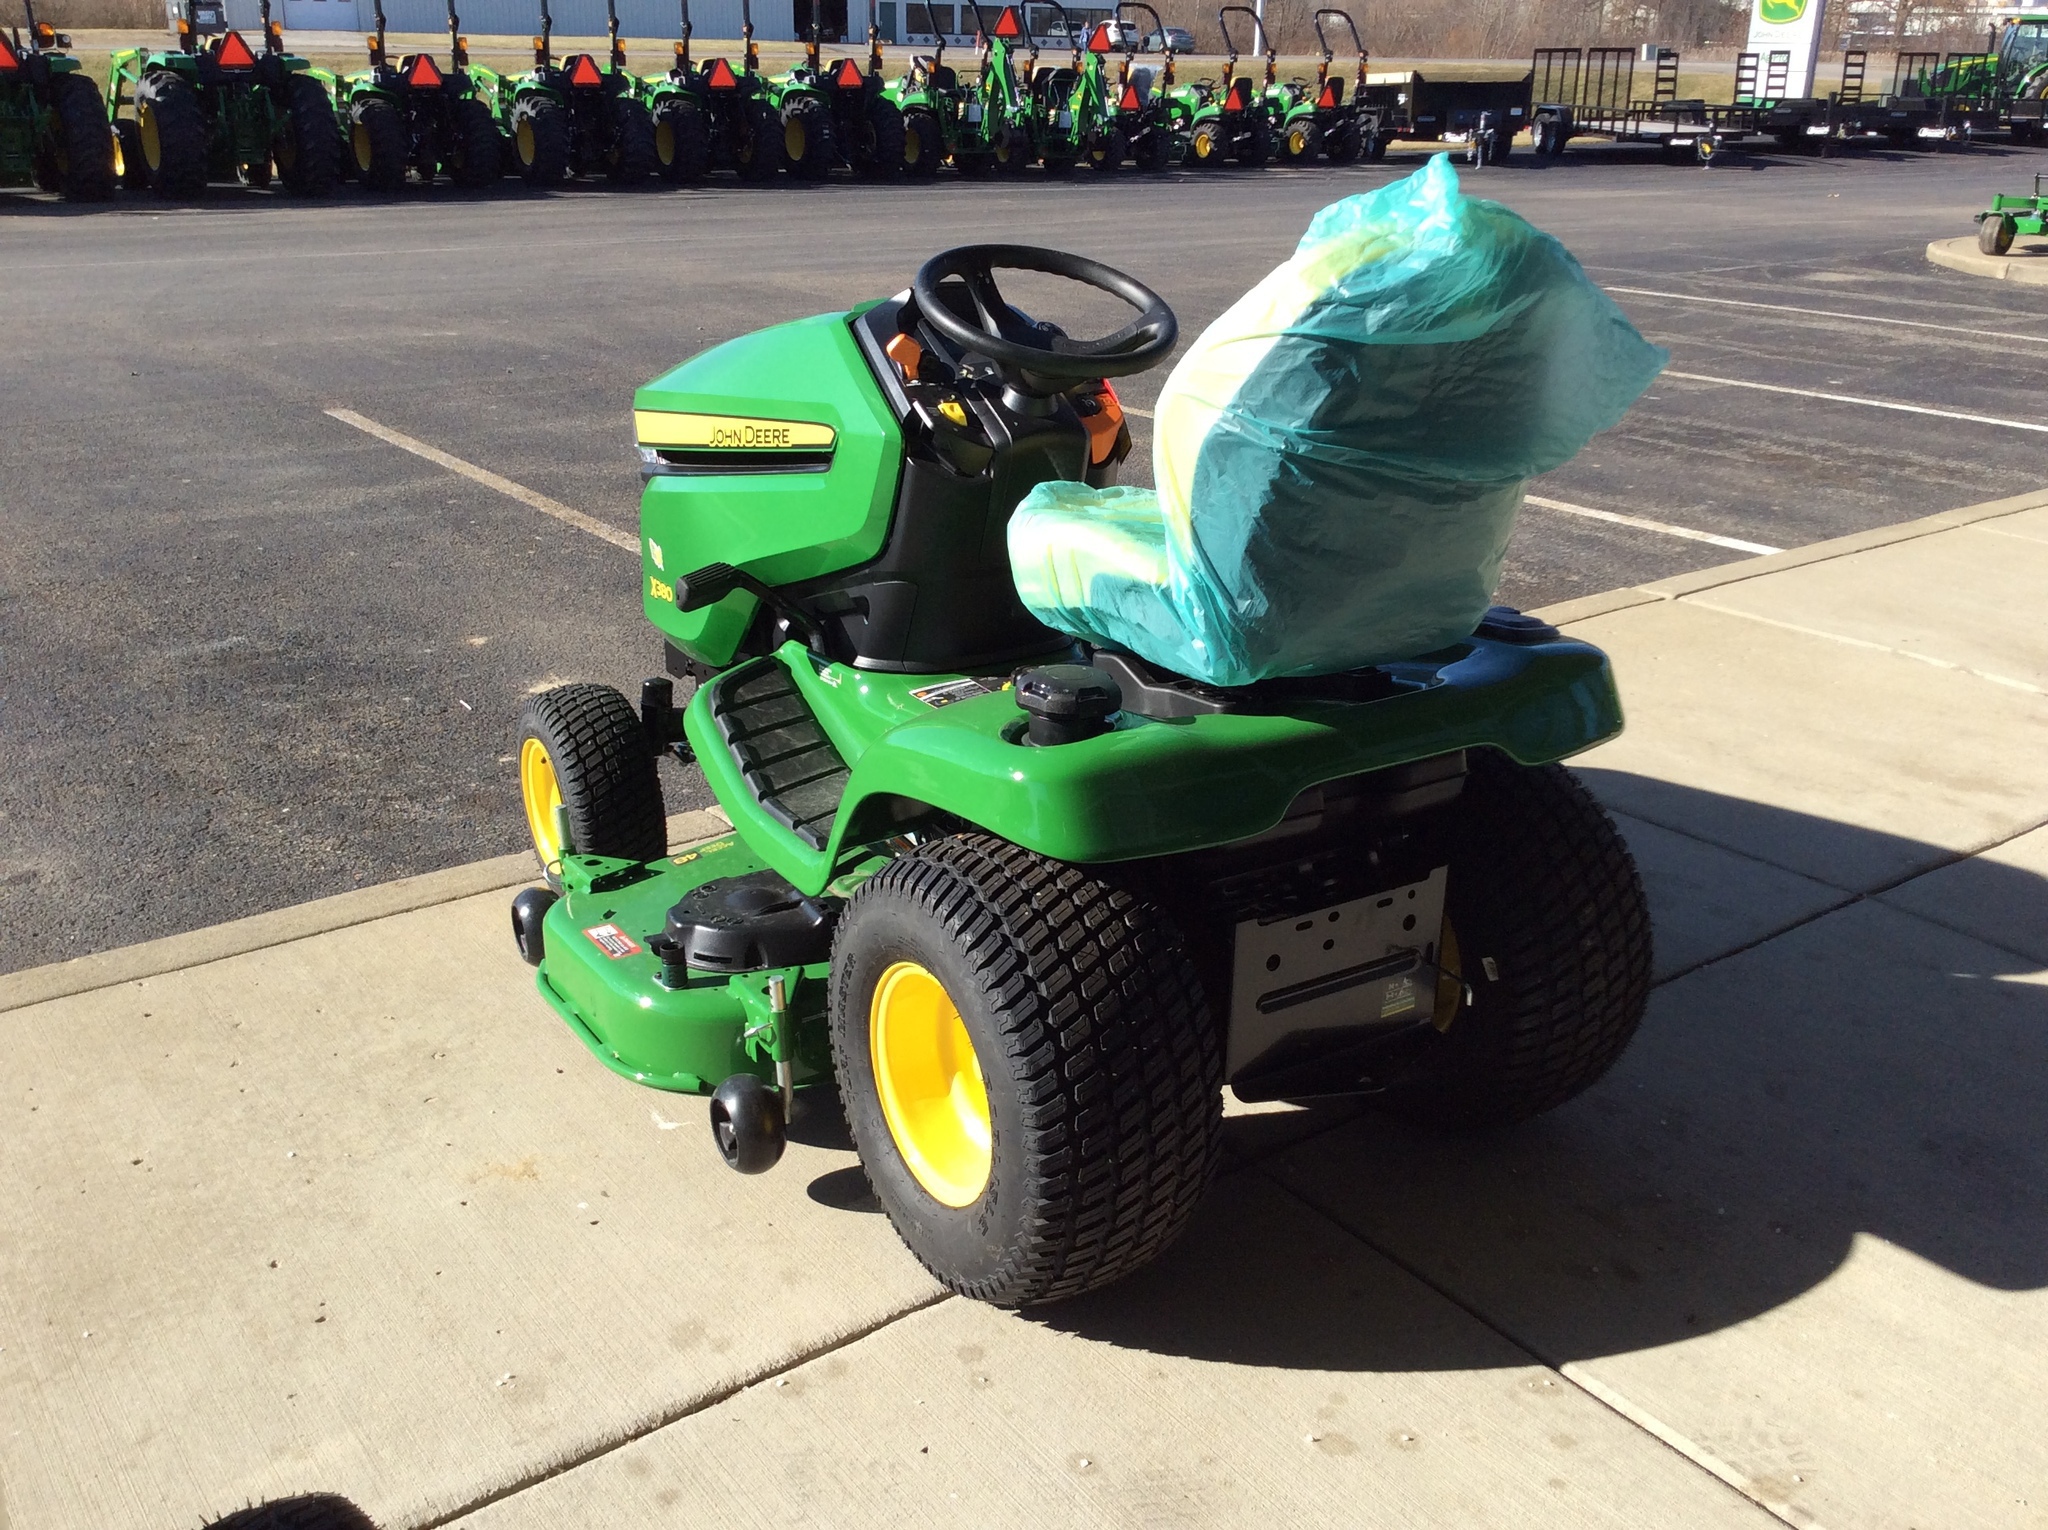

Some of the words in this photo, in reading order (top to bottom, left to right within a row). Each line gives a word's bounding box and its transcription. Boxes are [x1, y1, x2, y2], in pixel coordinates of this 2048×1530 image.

[709, 426, 742, 445] JOHN
[744, 425, 791, 445] DEERE
[836, 952, 857, 1038] MASTER
